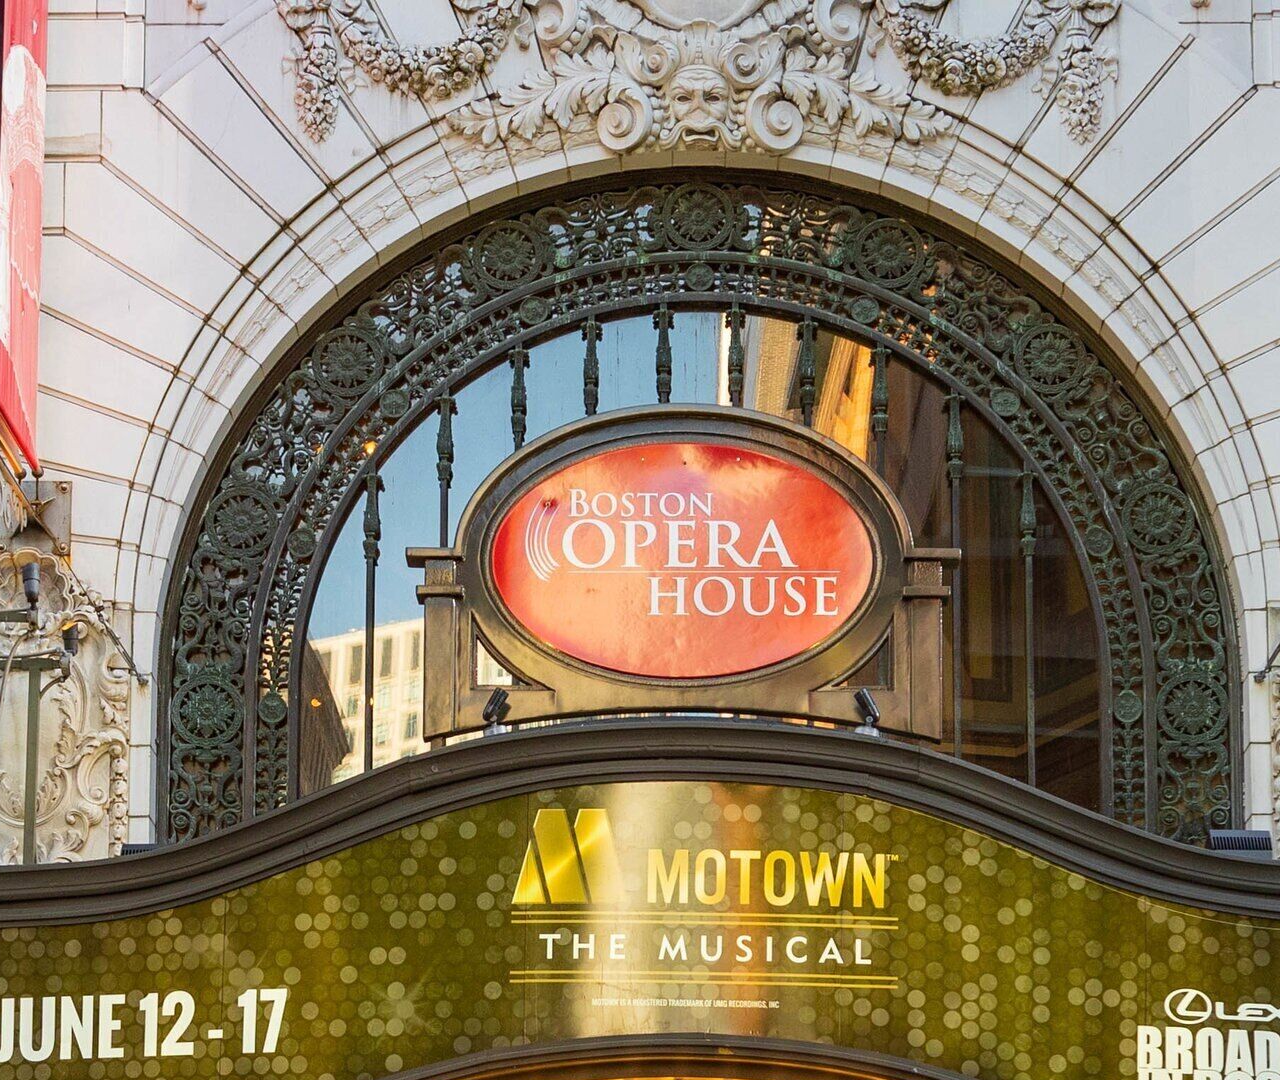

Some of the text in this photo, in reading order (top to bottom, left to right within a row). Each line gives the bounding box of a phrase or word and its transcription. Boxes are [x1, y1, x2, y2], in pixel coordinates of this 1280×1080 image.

[568, 488, 713, 517] BOSTON
[562, 518, 799, 570] OPERA
[647, 575, 839, 616] HOUSE
[539, 933, 872, 966] THE MUSICAL
[139, 990, 196, 1057] 12
[237, 987, 288, 1054] 17
[668, 999, 704, 1008] TRADEMARK
[704, 999, 712, 1008] OF
